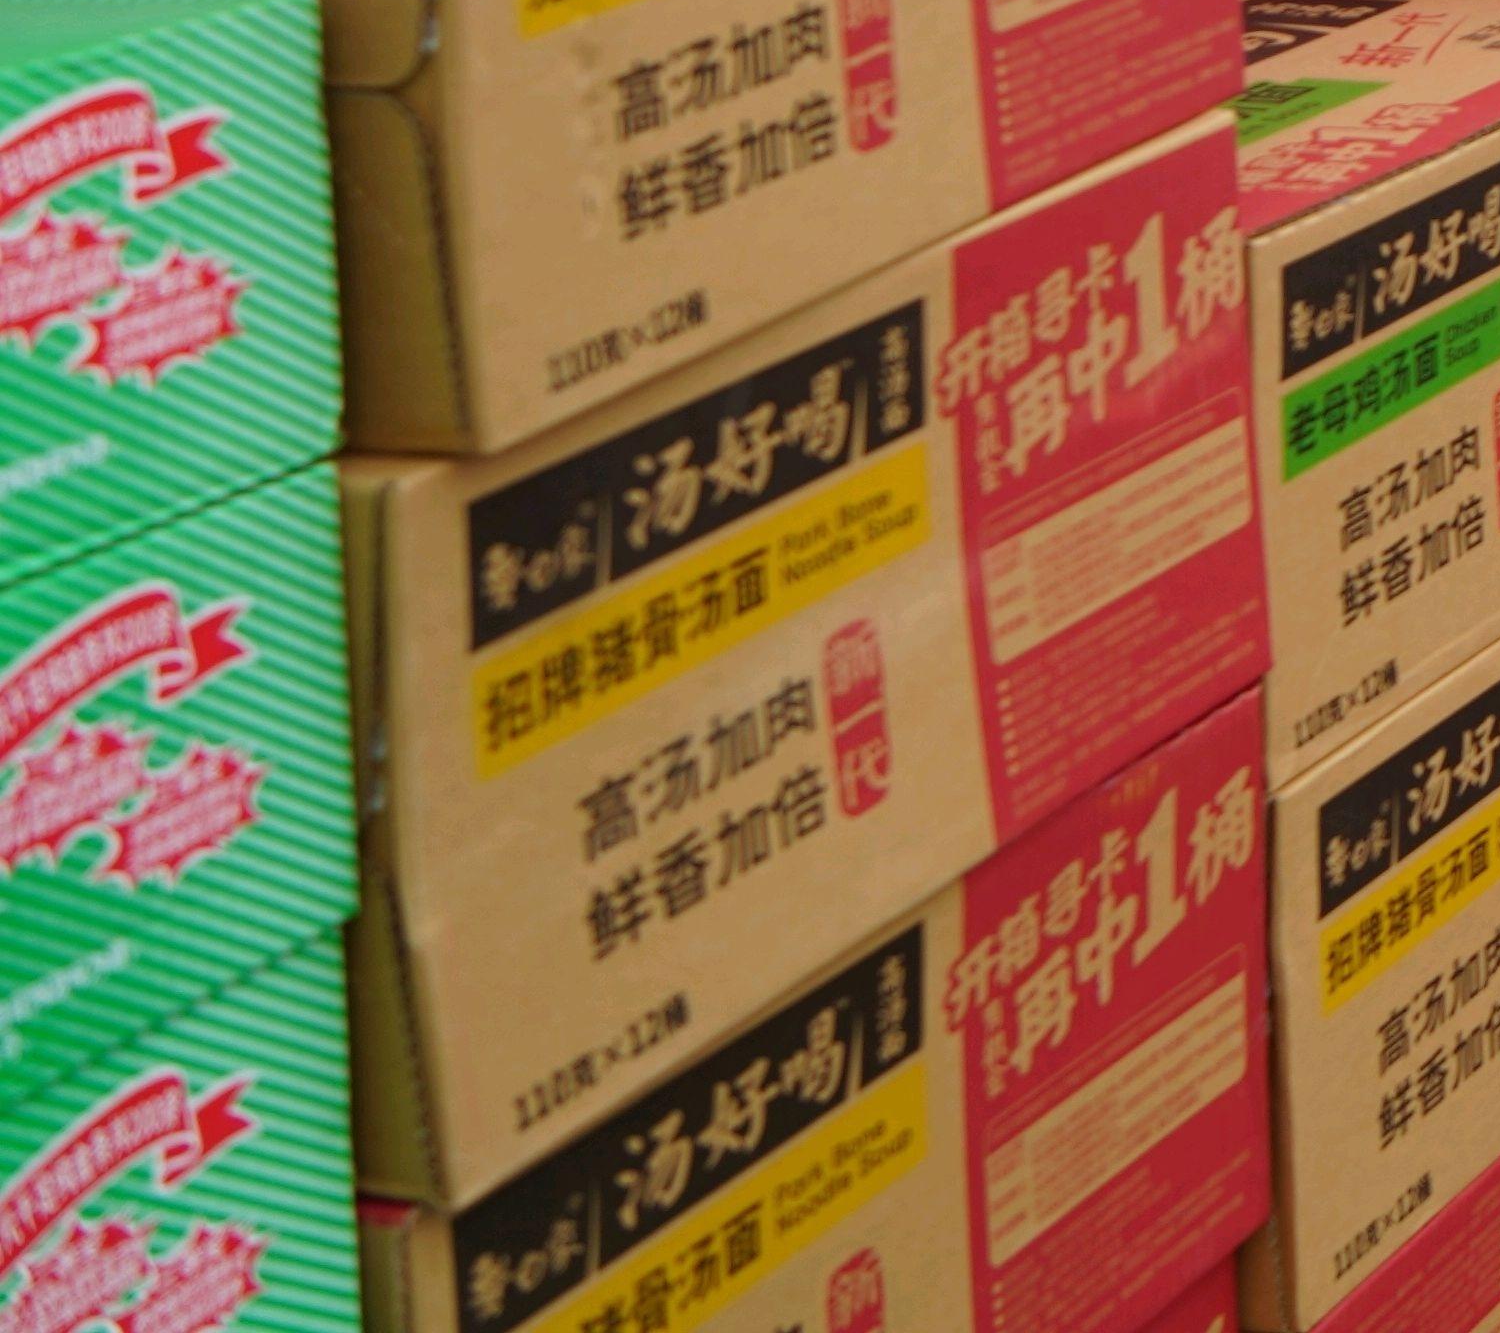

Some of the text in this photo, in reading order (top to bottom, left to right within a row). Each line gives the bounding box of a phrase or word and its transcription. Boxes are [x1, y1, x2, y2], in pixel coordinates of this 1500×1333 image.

[614, 3, 830, 140] 高汤加肉
[619, 93, 838, 239] 鲜香加倍
[624, 367, 853, 548] 汤好喝
[1287, 329, 1442, 454] 老母鸡汤面
[1339, 426, 1481, 551] 高汤加肉
[1339, 495, 1487, 628] 鲜香加倍
[576, 676, 817, 865] 高汤加肉
[586, 765, 828, 960] 鲜香加倍
[613, 1004, 850, 1230] 汤好喝
